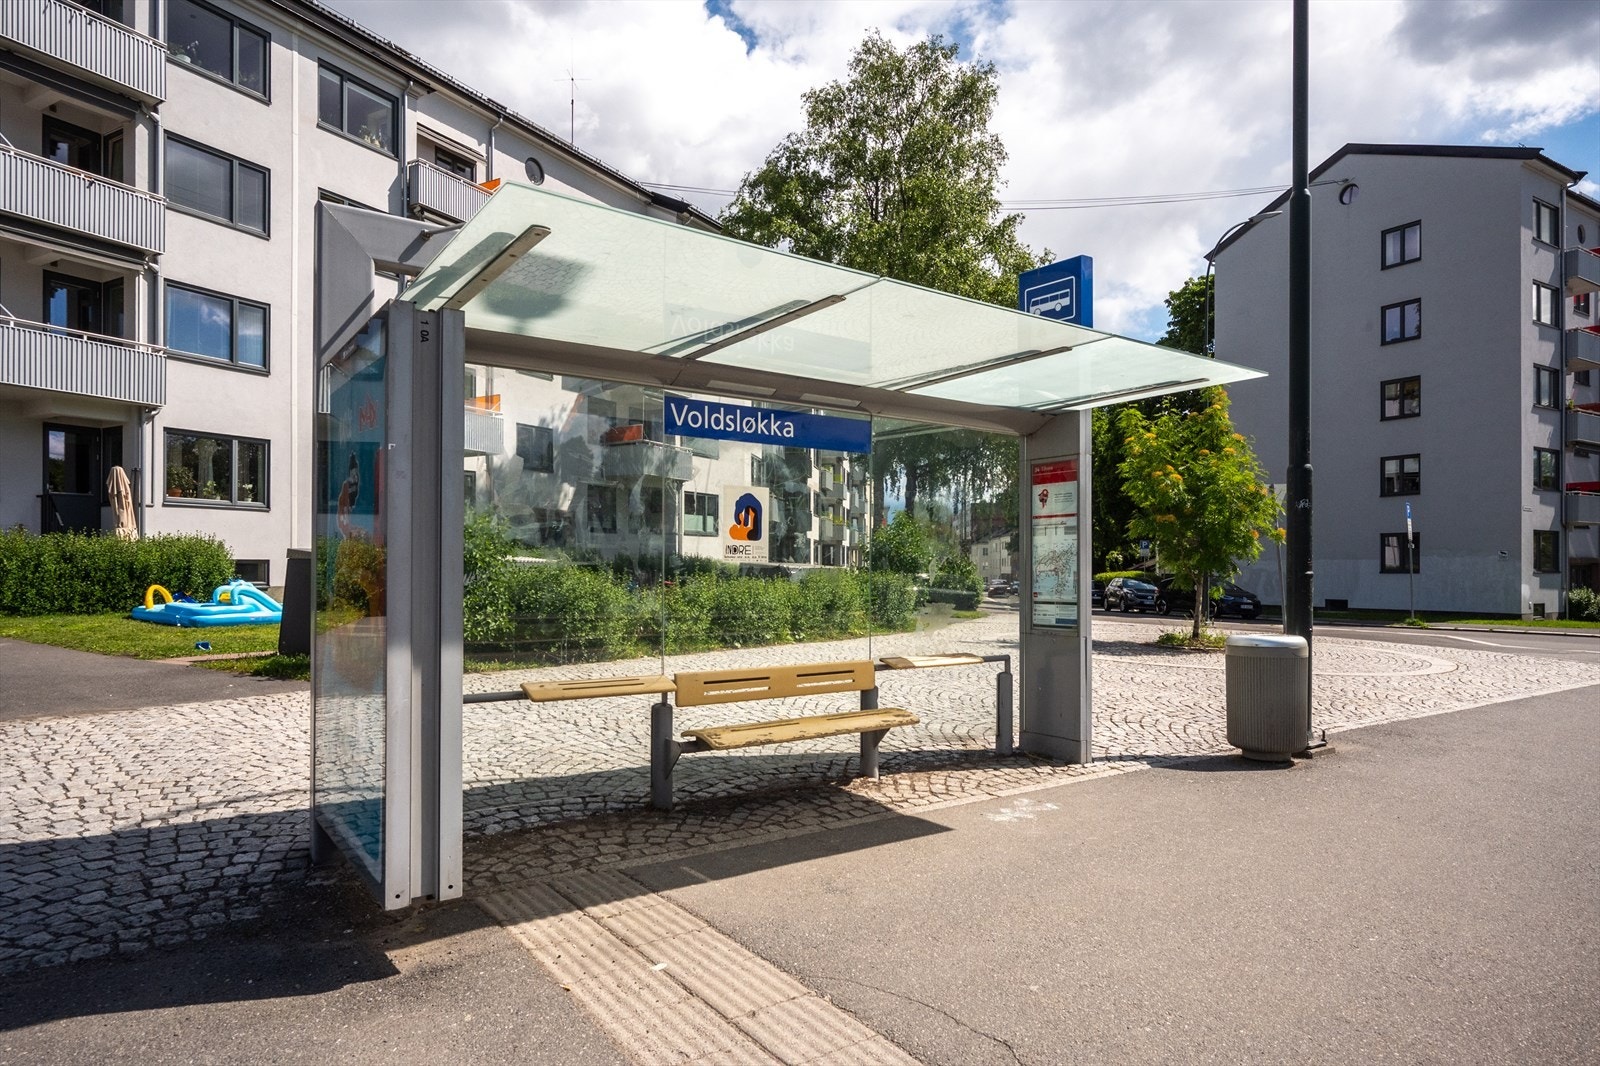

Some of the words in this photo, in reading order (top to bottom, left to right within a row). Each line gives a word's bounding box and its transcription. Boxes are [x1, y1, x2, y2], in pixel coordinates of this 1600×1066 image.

[670, 402, 795, 438] Voldsløkka
[725, 544, 752, 555] INDRE
[1142, 541, 1148, 549] P
